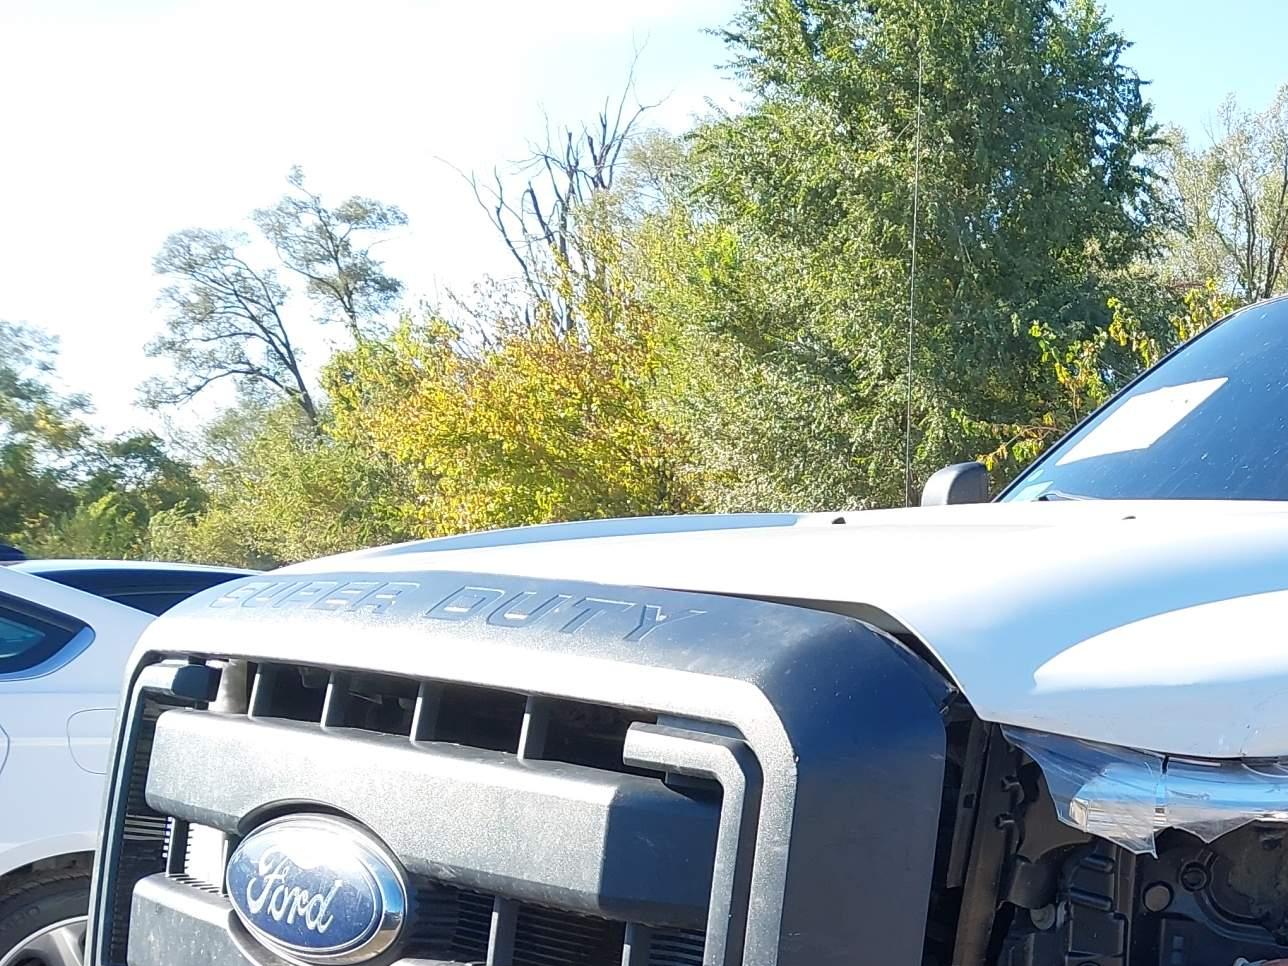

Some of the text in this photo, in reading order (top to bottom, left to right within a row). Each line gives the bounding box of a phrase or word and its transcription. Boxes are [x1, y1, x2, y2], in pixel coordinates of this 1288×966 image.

[209, 581, 708, 642] SUPER DUTY
[246, 849, 343, 934] Ford
